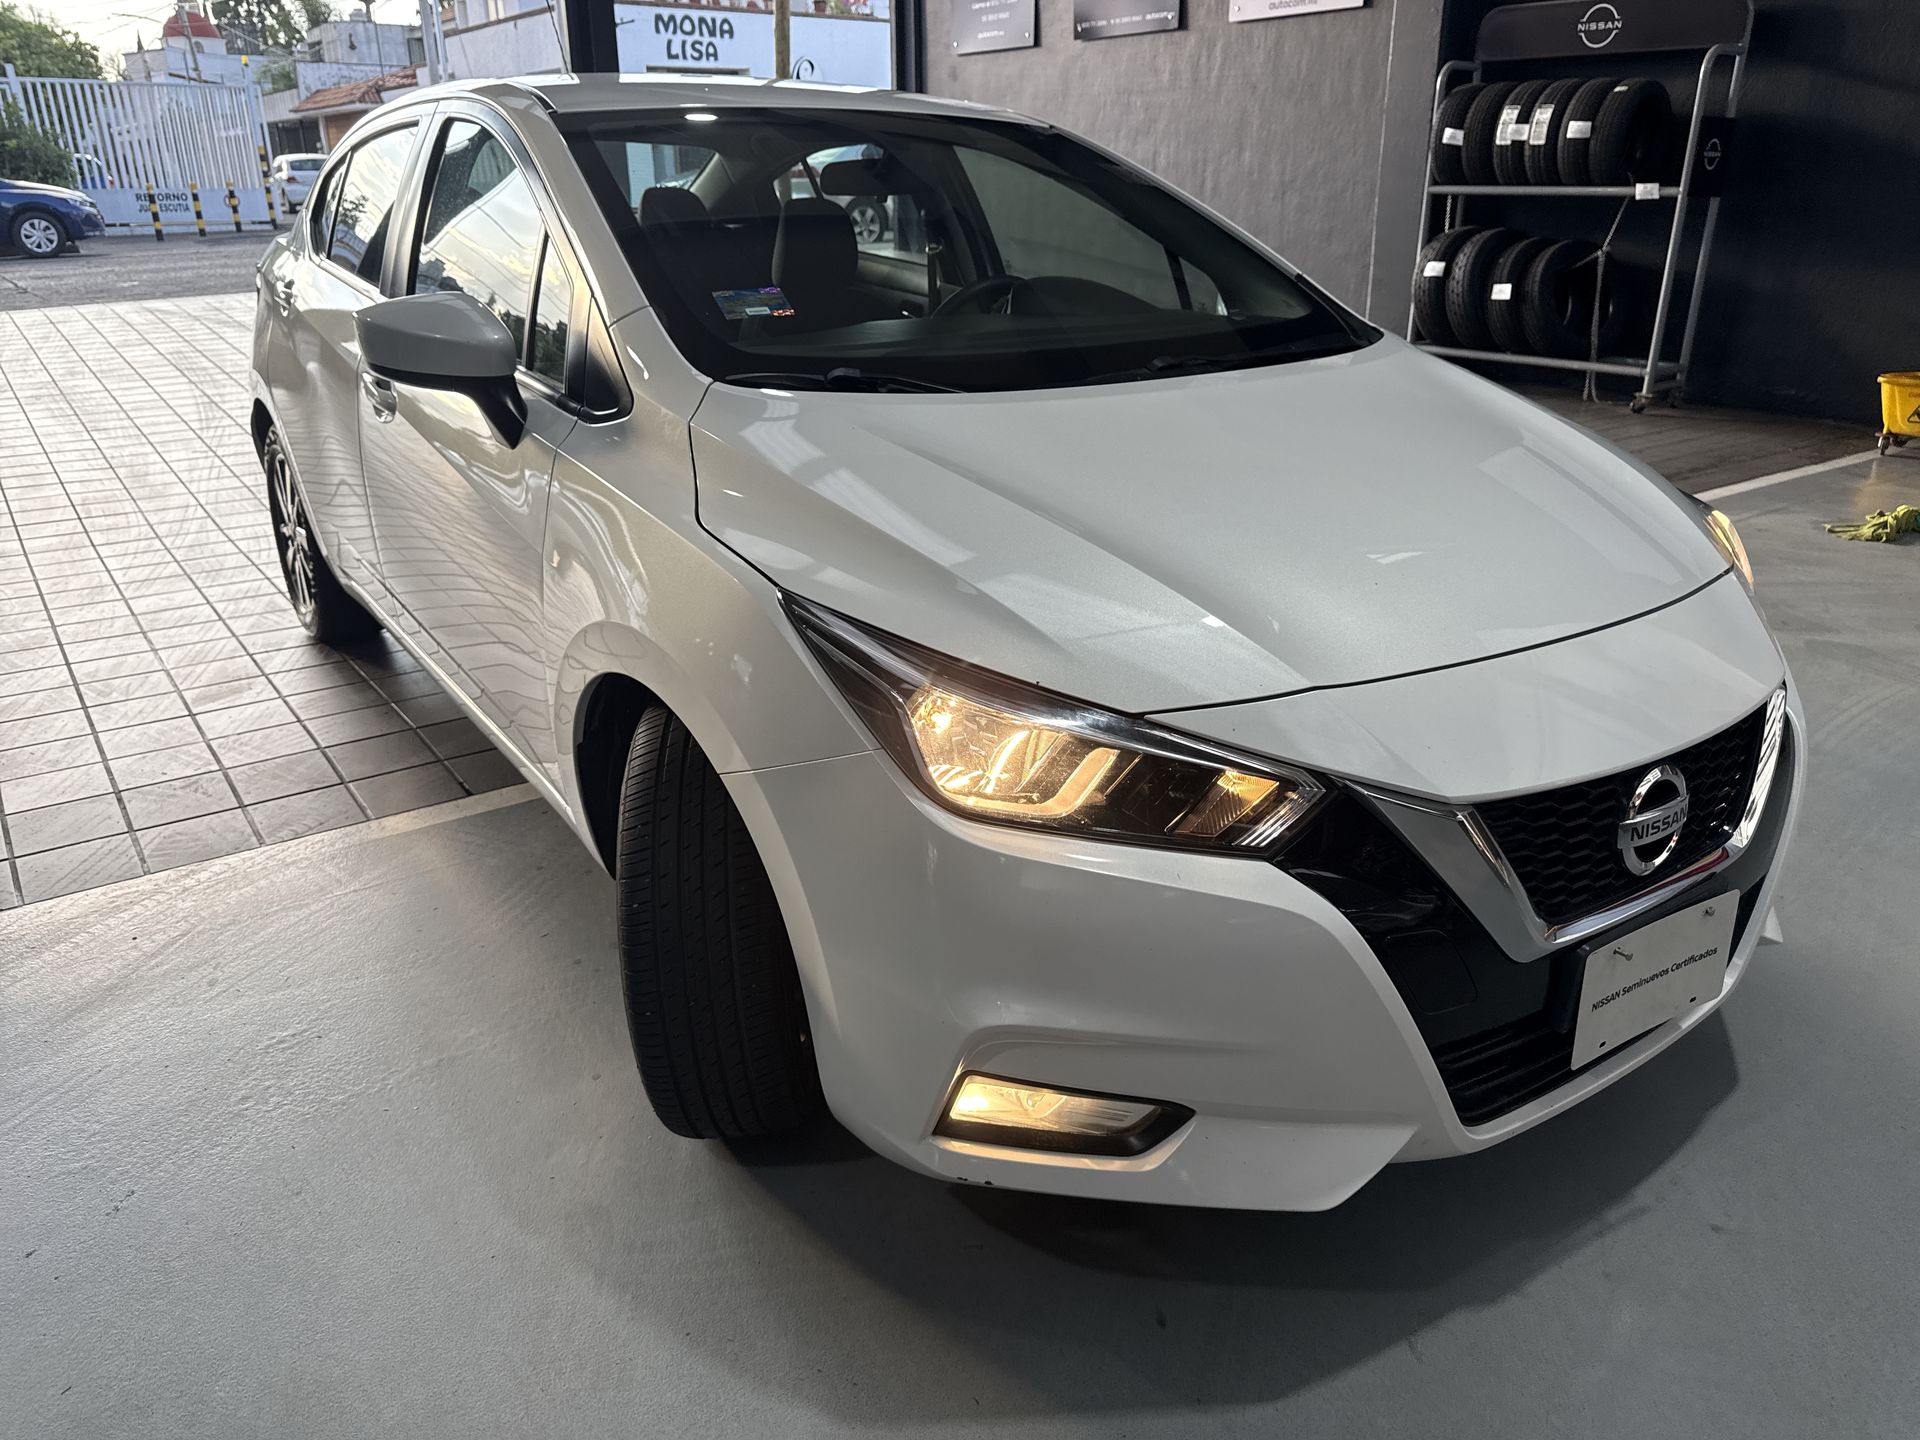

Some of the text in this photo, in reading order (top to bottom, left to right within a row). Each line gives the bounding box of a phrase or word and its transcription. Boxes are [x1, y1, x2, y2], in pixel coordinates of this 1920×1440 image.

[654, 13, 734, 39] MONA
[1577, 20, 1622, 31] NISSAN
[666, 39, 719, 61] LISA
[135, 192, 188, 202] REORNO
[159, 203, 191, 213] ESCUTIA
[1630, 804, 1687, 841] NISSAN
[1591, 947, 1718, 1012] NISSAN Seminuevos Certificados
